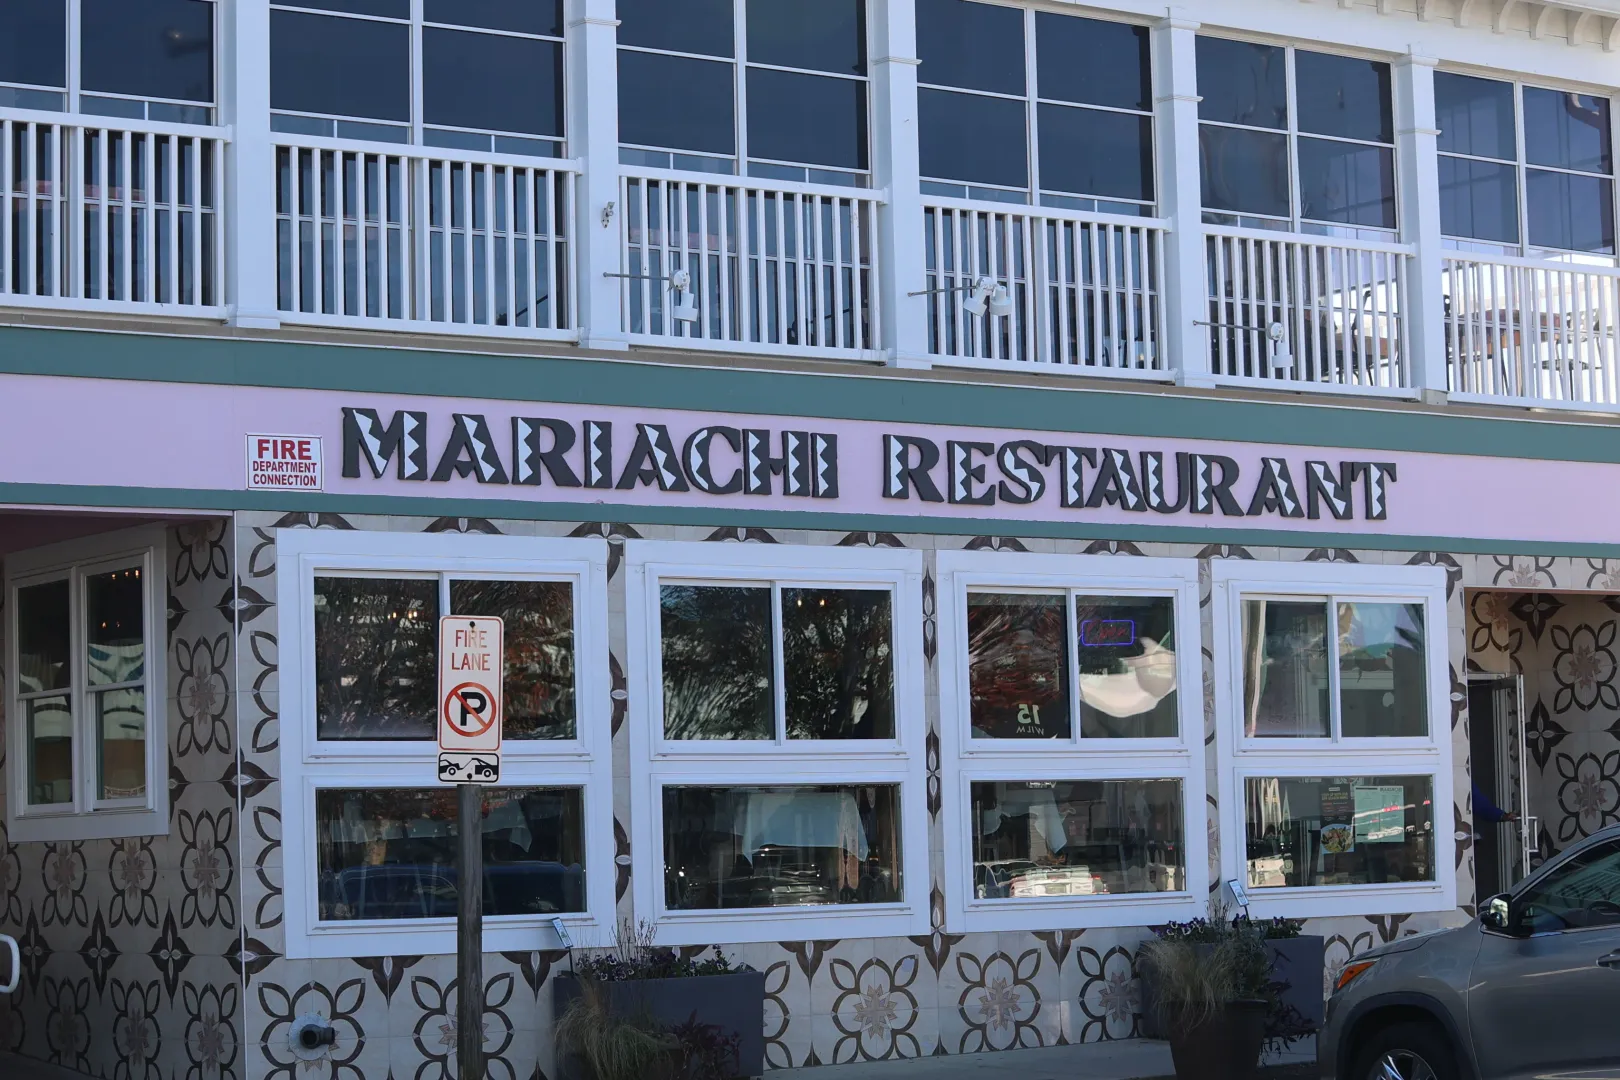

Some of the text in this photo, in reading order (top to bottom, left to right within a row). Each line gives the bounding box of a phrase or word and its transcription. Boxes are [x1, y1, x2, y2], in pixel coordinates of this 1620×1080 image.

[257, 438, 312, 461] FIRE
[252, 460, 317, 474] DEPARTMENT
[341, 406, 1398, 521] MARIACHI RESTAURANT
[253, 473, 317, 487] CONNECTION
[455, 629, 488, 648] FIRE
[451, 652, 491, 671] LANE
